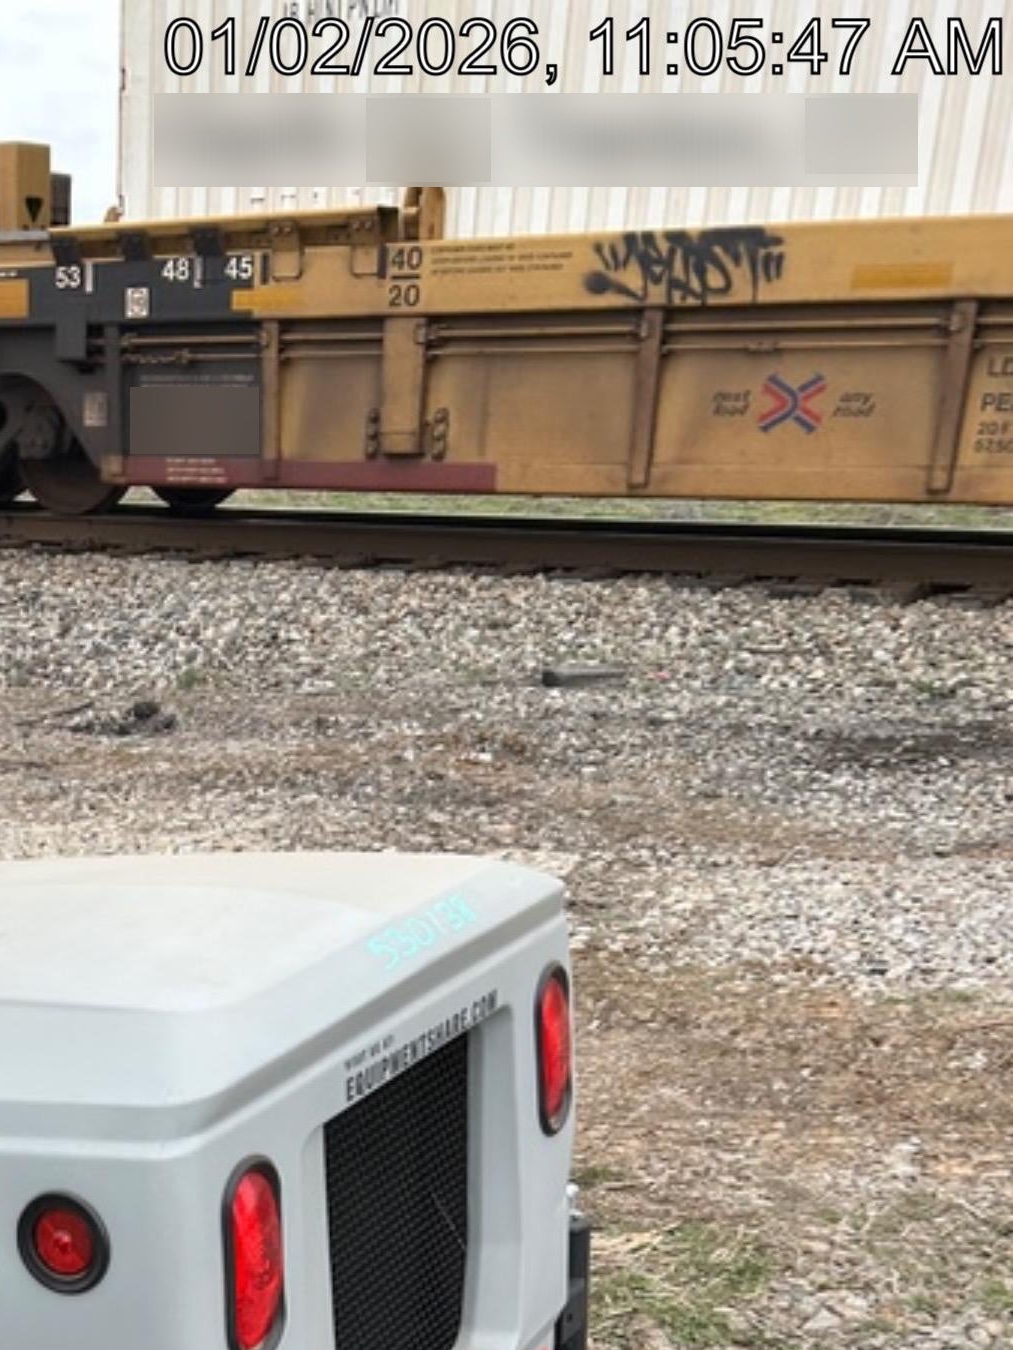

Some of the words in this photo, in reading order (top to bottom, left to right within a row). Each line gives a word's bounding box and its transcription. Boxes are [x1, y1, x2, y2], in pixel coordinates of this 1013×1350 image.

[161, 258, 190, 281] 48
[224, 256, 253, 279] 45
[390, 247, 423, 271] 40
[55, 266, 81, 289] 53
[388, 283, 421, 307] 20
